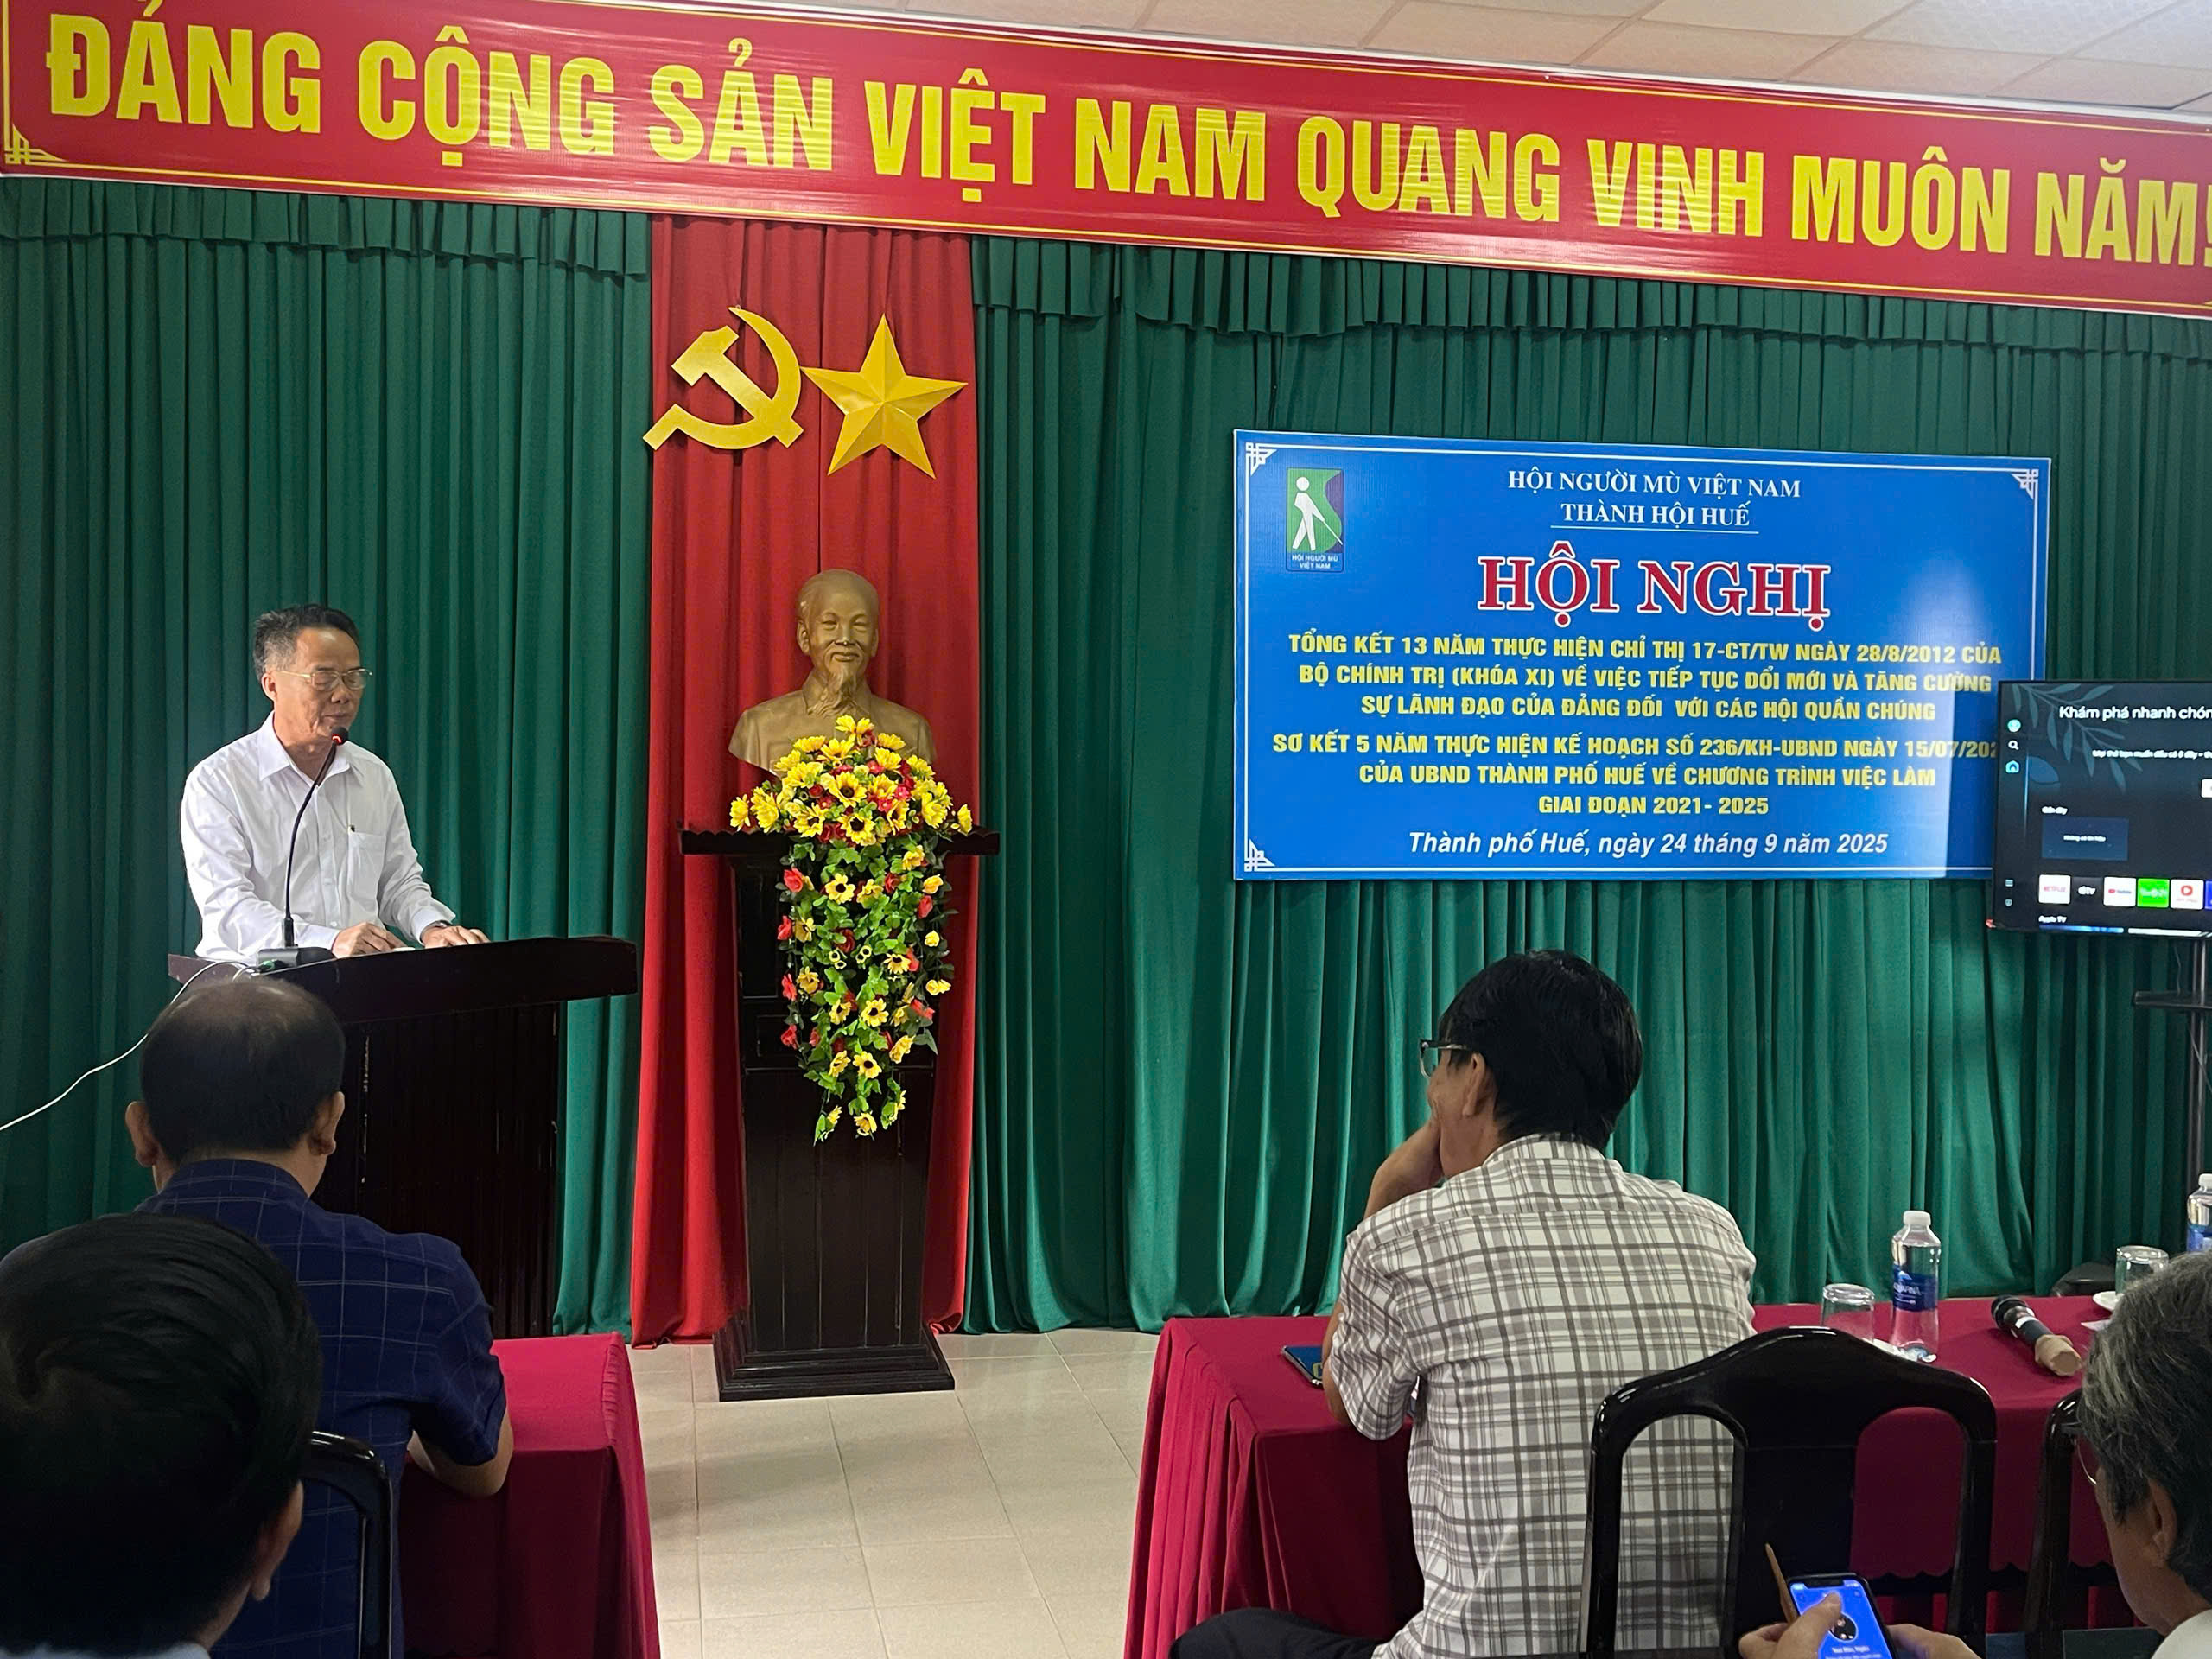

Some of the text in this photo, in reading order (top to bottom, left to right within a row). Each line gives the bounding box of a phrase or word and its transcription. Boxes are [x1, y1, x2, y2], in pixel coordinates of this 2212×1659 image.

[46, 0, 320, 133] ĐẢNG
[359, 25, 615, 167] CỘNG
[648, 38, 833, 171] SẢN
[864, 68, 1046, 202] VIỆT
[1075, 98, 1265, 201] NAM
[1298, 116, 1560, 221] QUANG
[1587, 139, 1764, 237] VINH
[1792, 146, 2009, 253] MUÔN
[1509, 467, 1799, 499] HỘI NGƯỜI MÙ VIỆT NAM
[1561, 496, 1750, 528] THÀNH HỘI HUẾ
[1478, 541, 1831, 632] HỘI NGHỊ
[1289, 628, 2001, 664] TỔNG KẾT 13 NĂM THỰC HIỆN CHỈ THỊ 17-CT/TW NGÀY 28/8/2012 CỦA
[1300, 662, 1991, 692] BỘ CHÍNH TRỊ (KHÓA XI) VỀ VIỆC TIẾP TỤC ĐỔI MỚI VÀ TĂNG CƯỜNG
[1362, 693, 1936, 721] SỰ LÃNH ĐẠO CỦA ĐẢNG ĐỐI VỚI CÁC HỘI QUẦN CHÚNG
[2060, 706, 2100, 718] Khám
[2103, 706, 2129, 721] phá
[2133, 707, 2176, 718] nhanh
[1273, 733, 1302, 752] SƠ
[1310, 730, 1349, 752] KẾT
[1357, 735, 1369, 753] 5
[1376, 733, 1427, 753] NĂM
[1435, 735, 1490, 756] THỰC
[1497, 733, 1547, 757] HIỆN
[1554, 733, 1581, 753] KẾ
[1588, 737, 1659, 759] HOẠCH
[1666, 735, 1694, 755] SỐ
[1700, 739, 1837, 756] 236/KH-UBND
[1844, 737, 1897, 757] NGÀY
[1359, 760, 1936, 789] CỦA UBND THÀNH PHỐ HUẾ VỀ CHƯƠNG TRÌNH VIỆC LÀM
[1539, 796, 1769, 817] GIAI ĐOẠN 2021- 2025
[1410, 830, 1888, 858] Thành phố Huế, ngày 24 tháng 9 năm 2025
